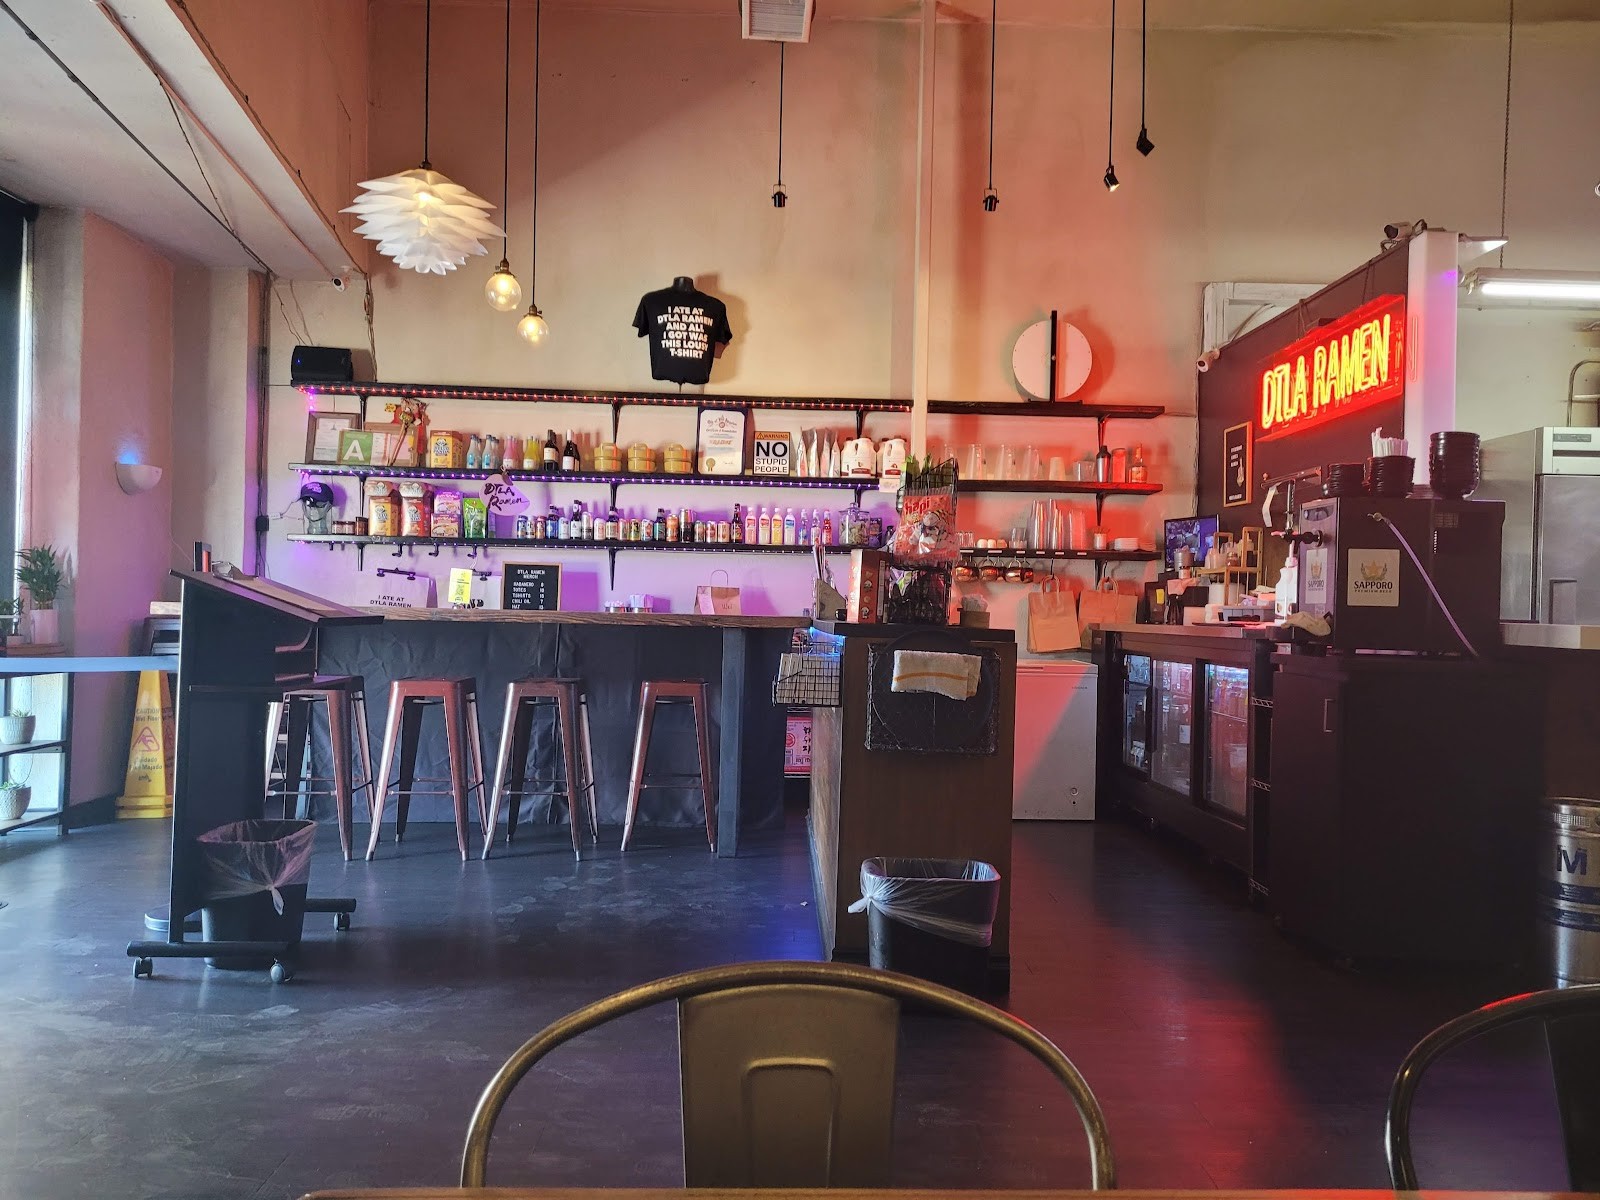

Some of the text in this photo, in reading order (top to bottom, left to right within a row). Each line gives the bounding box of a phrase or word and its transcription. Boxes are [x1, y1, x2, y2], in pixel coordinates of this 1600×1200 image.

[672, 306, 690, 314] ATE
[657, 314, 713, 326] DTLA RAMEN
[666, 322, 704, 333] AND ALL
[668, 331, 687, 339] GOT
[689, 332, 708, 342] WAS
[661, 340, 708, 351] THIS LOUSY
[670, 348, 704, 359] T-SHIRT
[1262, 314, 1391, 430] DTLA RAMEN
[342, 439, 365, 461] A
[756, 441, 788, 457] NO
[484, 483, 514, 496] DTLA
[1354, 581, 1393, 589] SAPPORO
